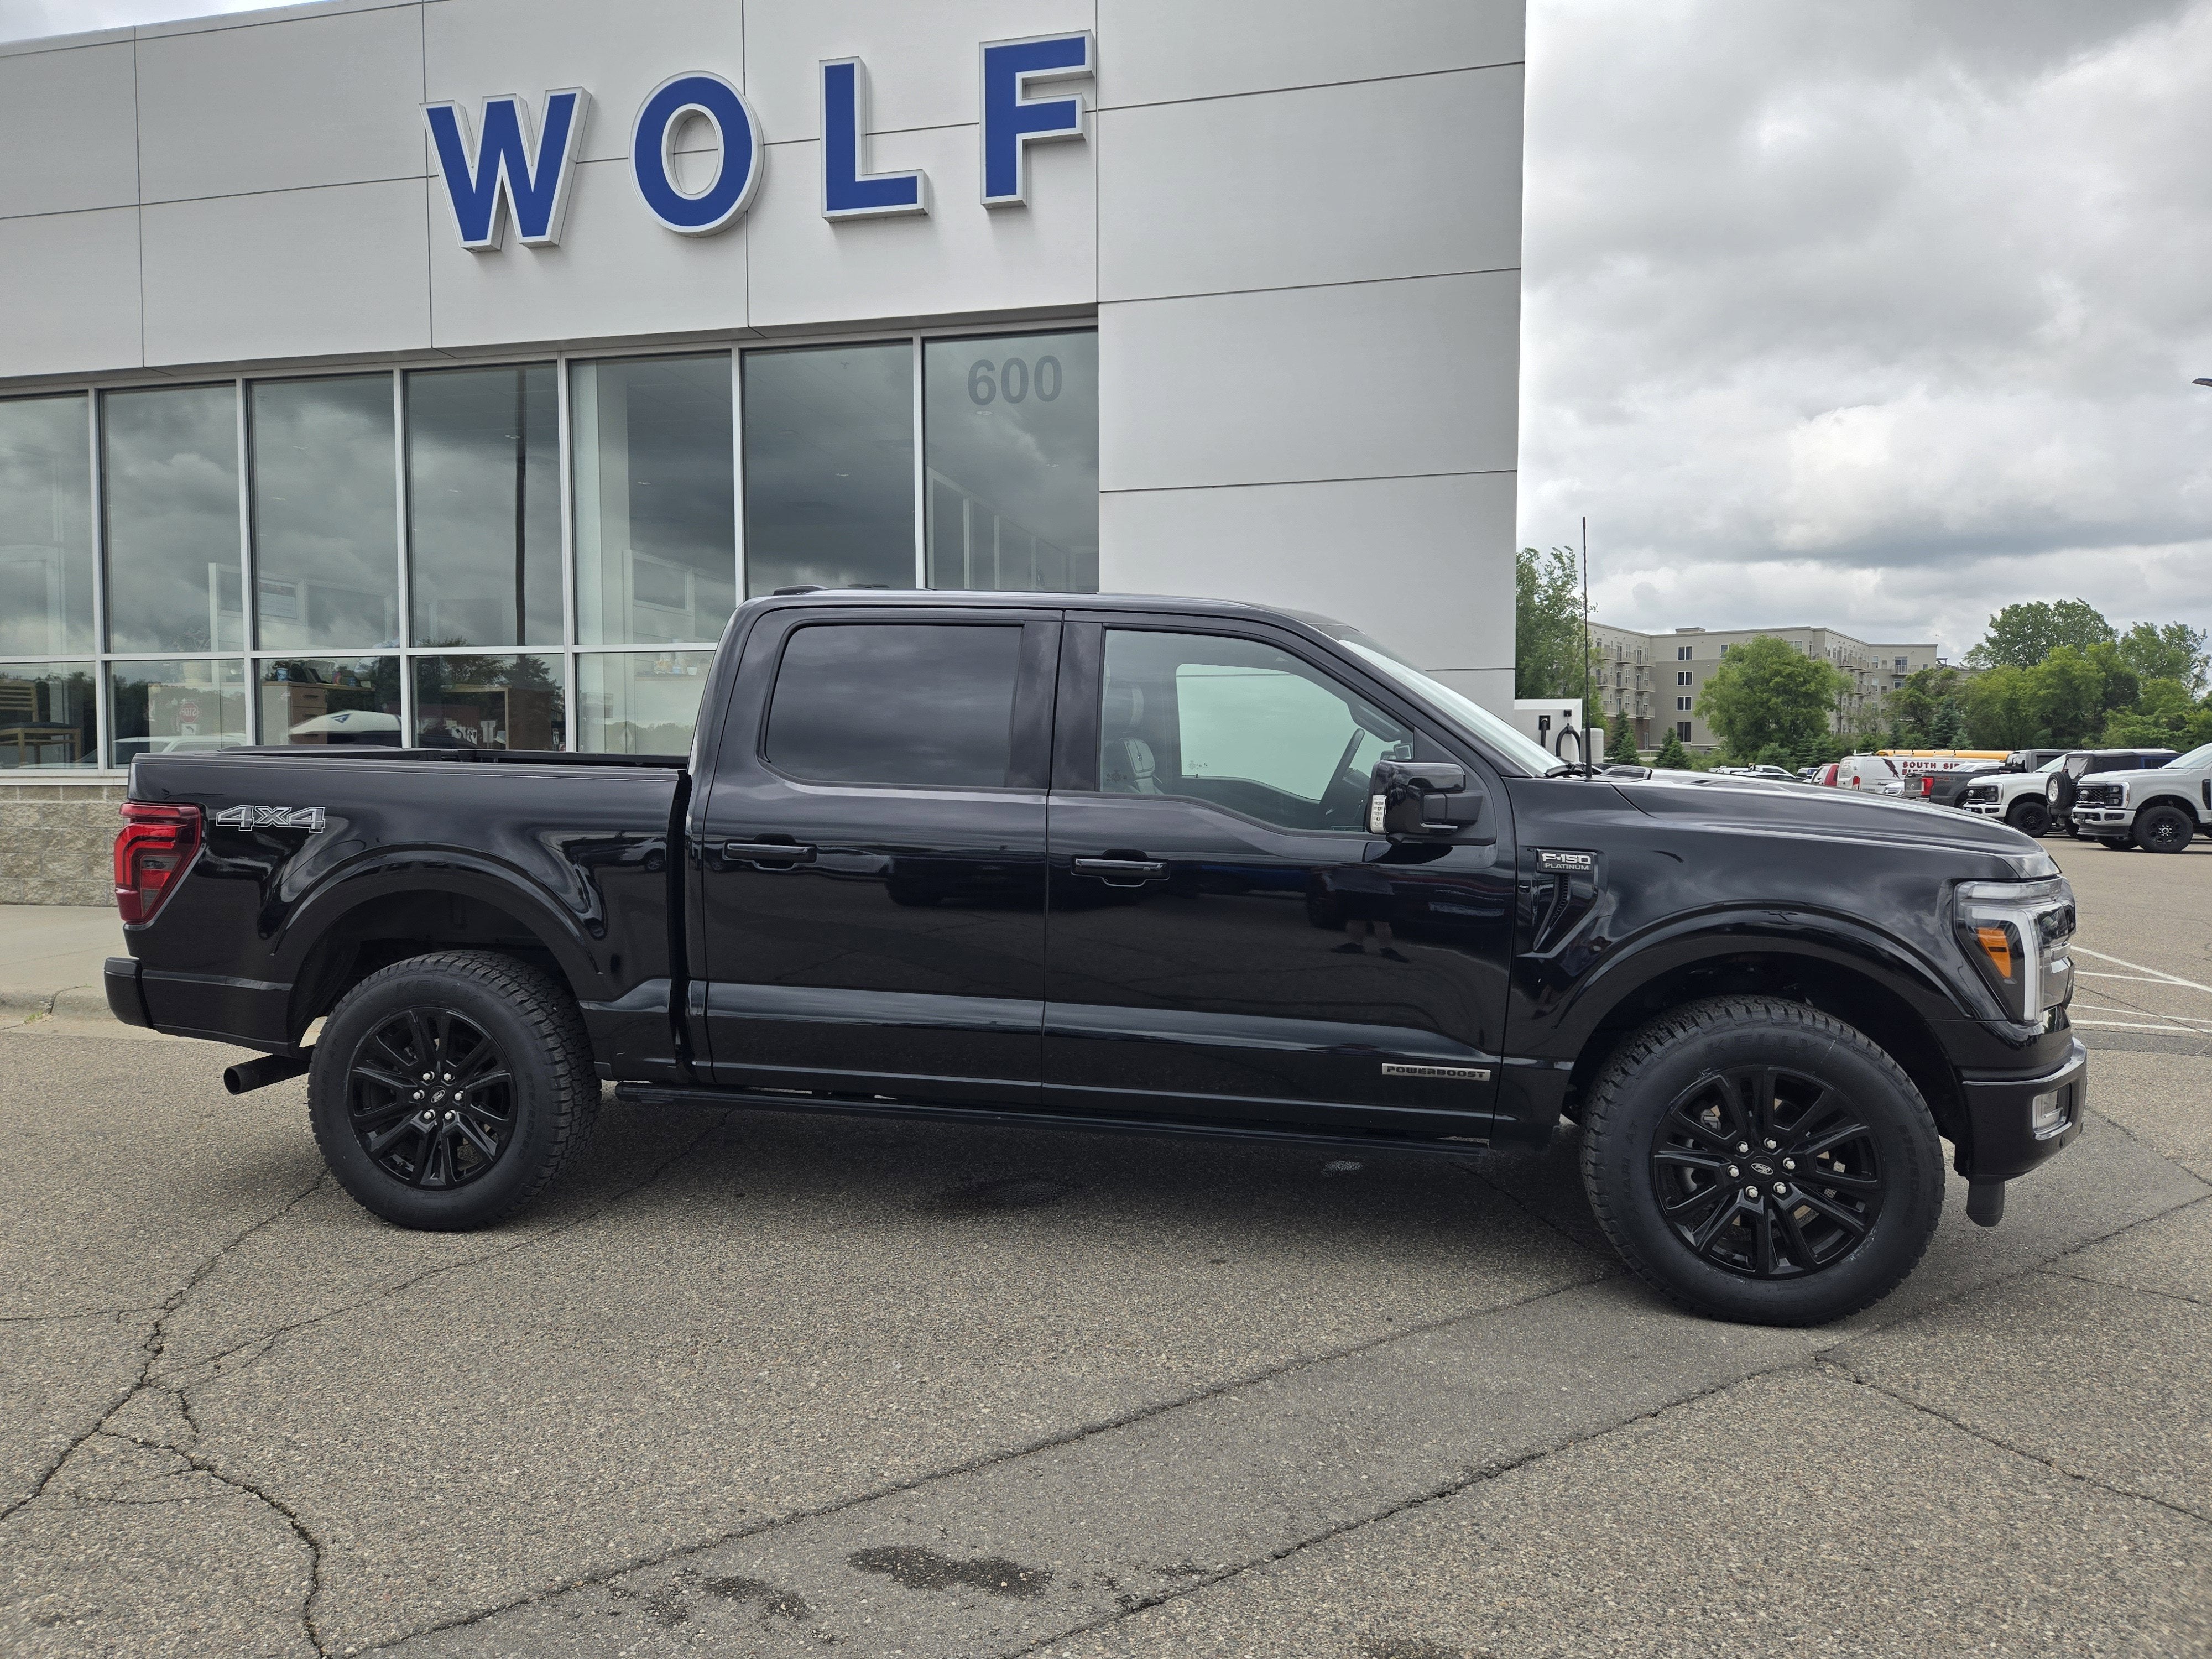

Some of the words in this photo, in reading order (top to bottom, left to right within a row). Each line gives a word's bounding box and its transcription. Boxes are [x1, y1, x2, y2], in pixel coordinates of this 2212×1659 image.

[420, 29, 1095, 252] WOLF
[968, 355, 1062, 406] 600
[1542, 853, 1591, 864] F-150
[1704, 1033, 1820, 1056] KELLY
[1387, 1066, 1485, 1078] POWERBOOST
